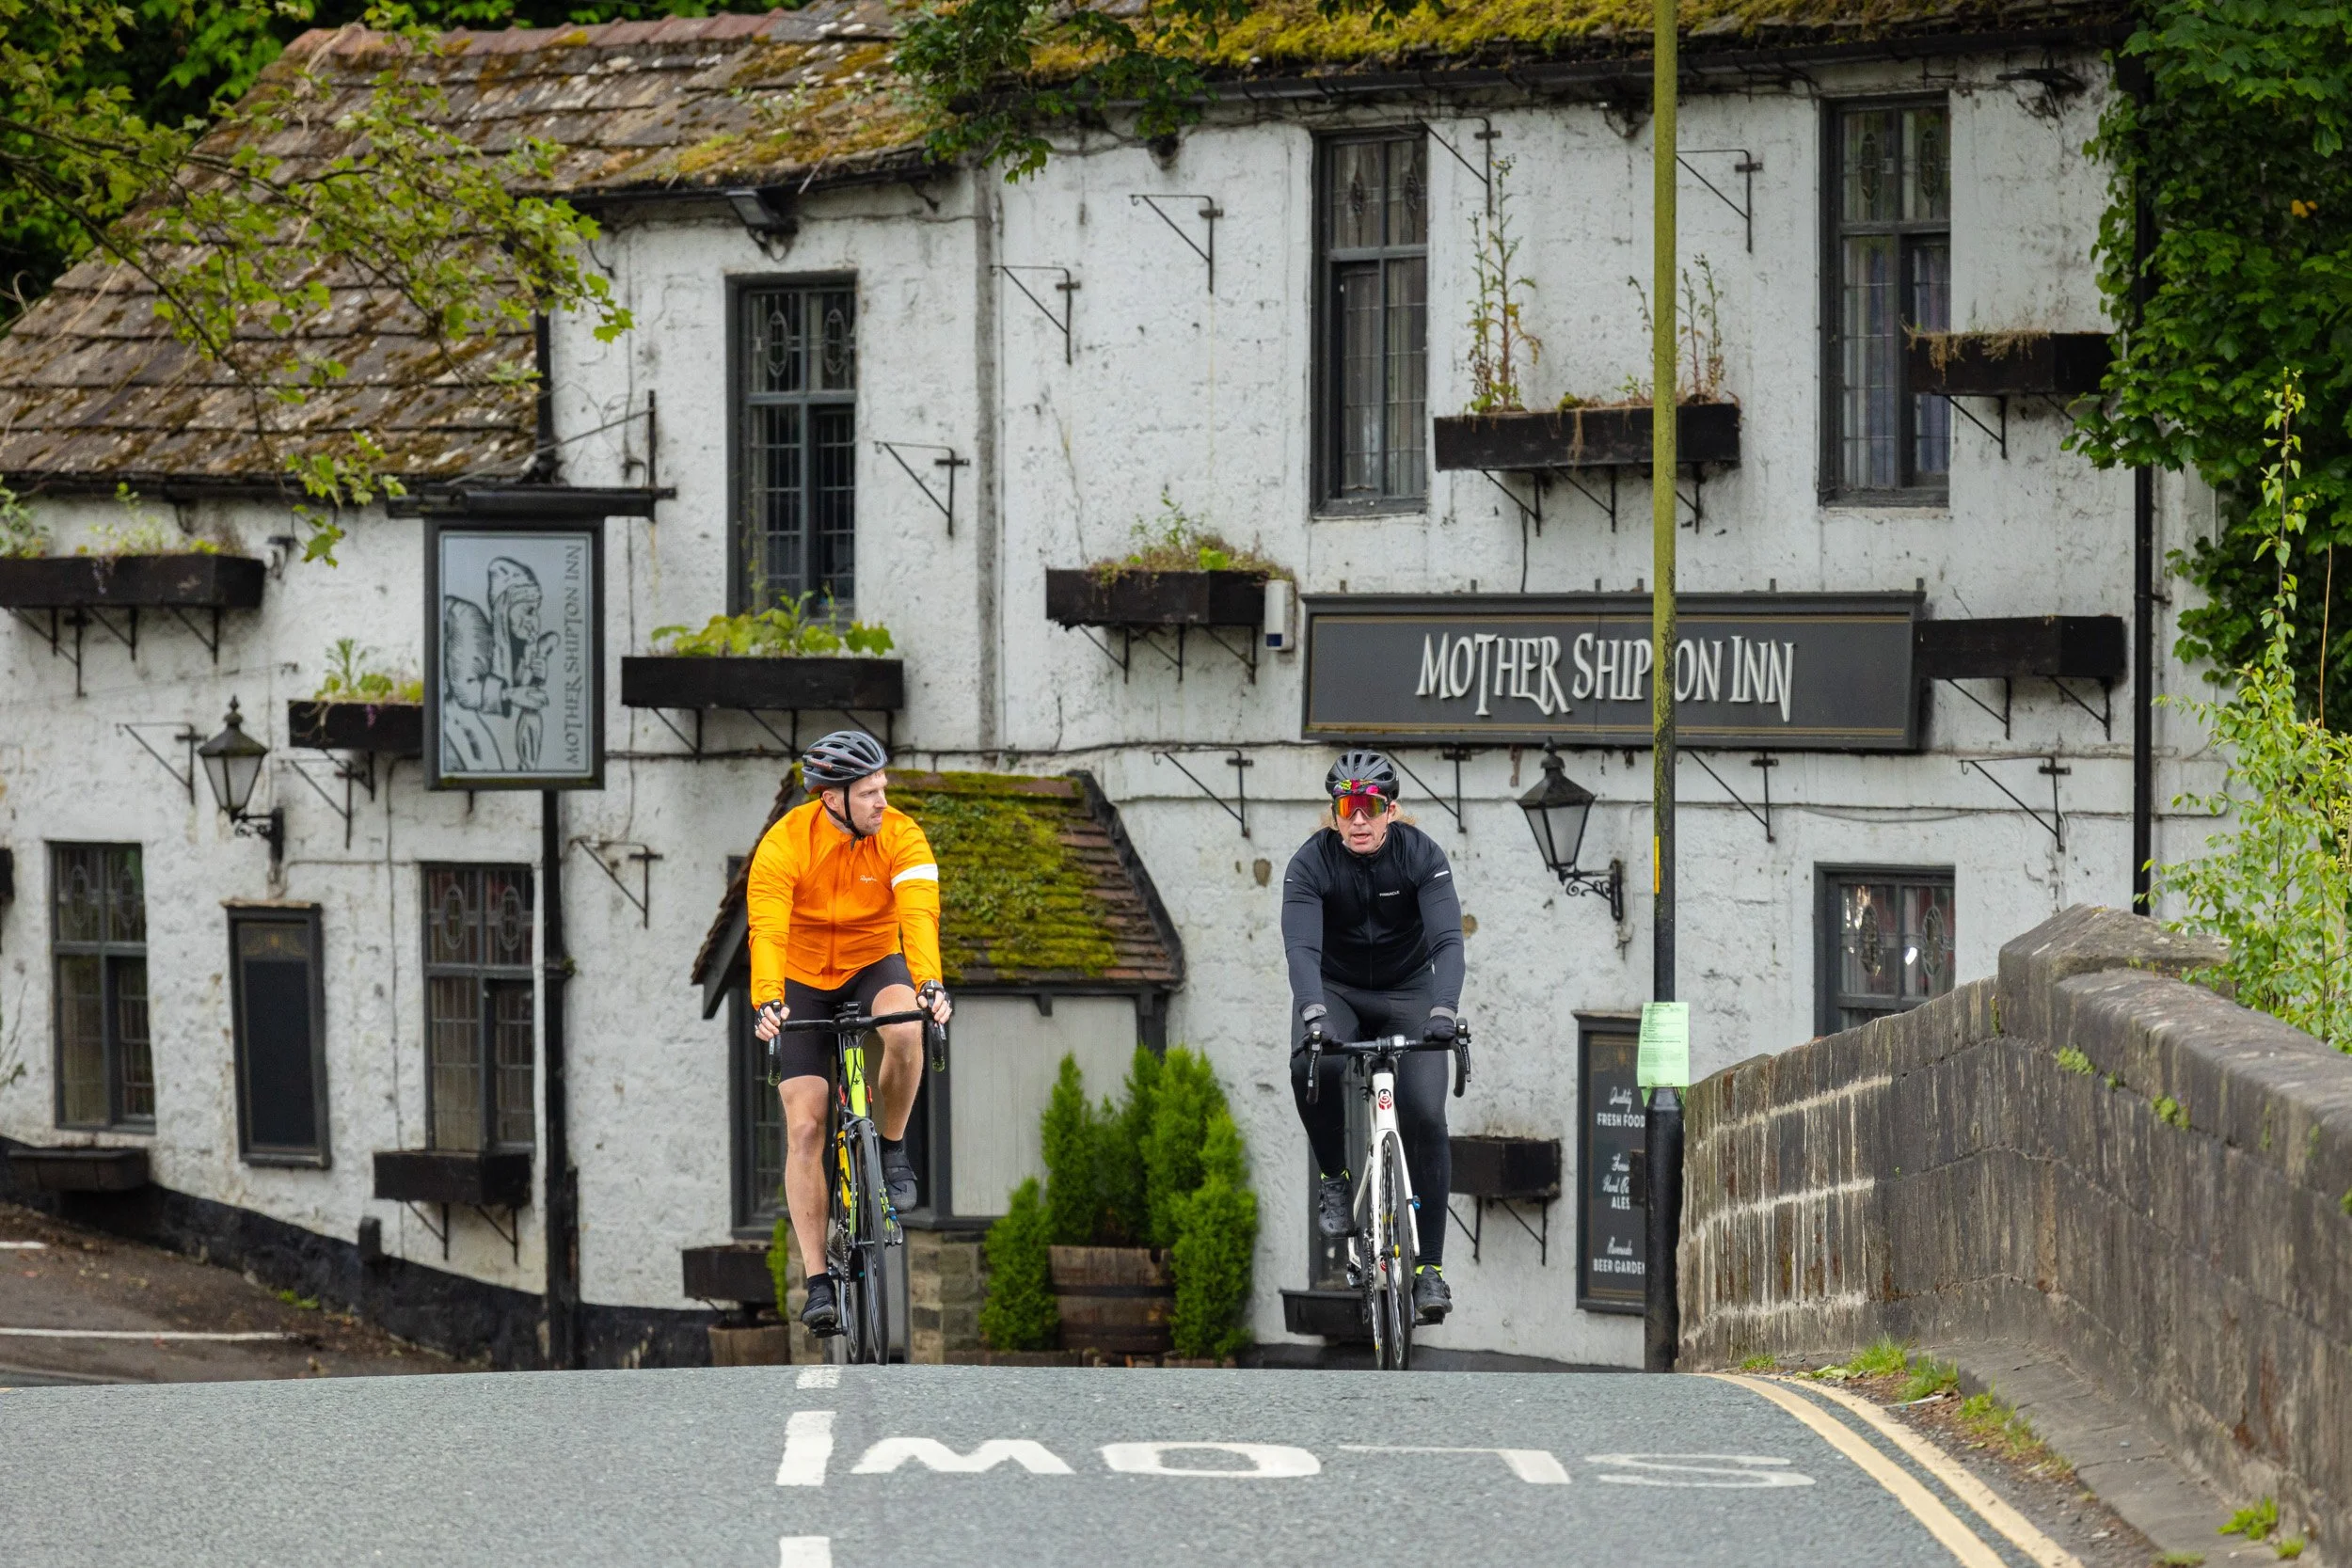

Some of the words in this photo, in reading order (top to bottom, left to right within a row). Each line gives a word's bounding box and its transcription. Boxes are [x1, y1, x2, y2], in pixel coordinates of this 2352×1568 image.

[564, 545, 582, 580] INN
[564, 586, 582, 673] SHIPTON
[1415, 632, 1571, 716] MOTHER
[1571, 632, 1723, 702] SHIPON
[1728, 635, 1795, 722] INN
[564, 675, 582, 766] MOTHER
[1597, 1113, 1622, 1127] FRESH
[1623, 1114, 1645, 1129] FOOD
[1611, 1196, 1630, 1211] ALES
[1593, 1258, 1613, 1274] BEER
[850, 1437, 1818, 1488] SLOW
